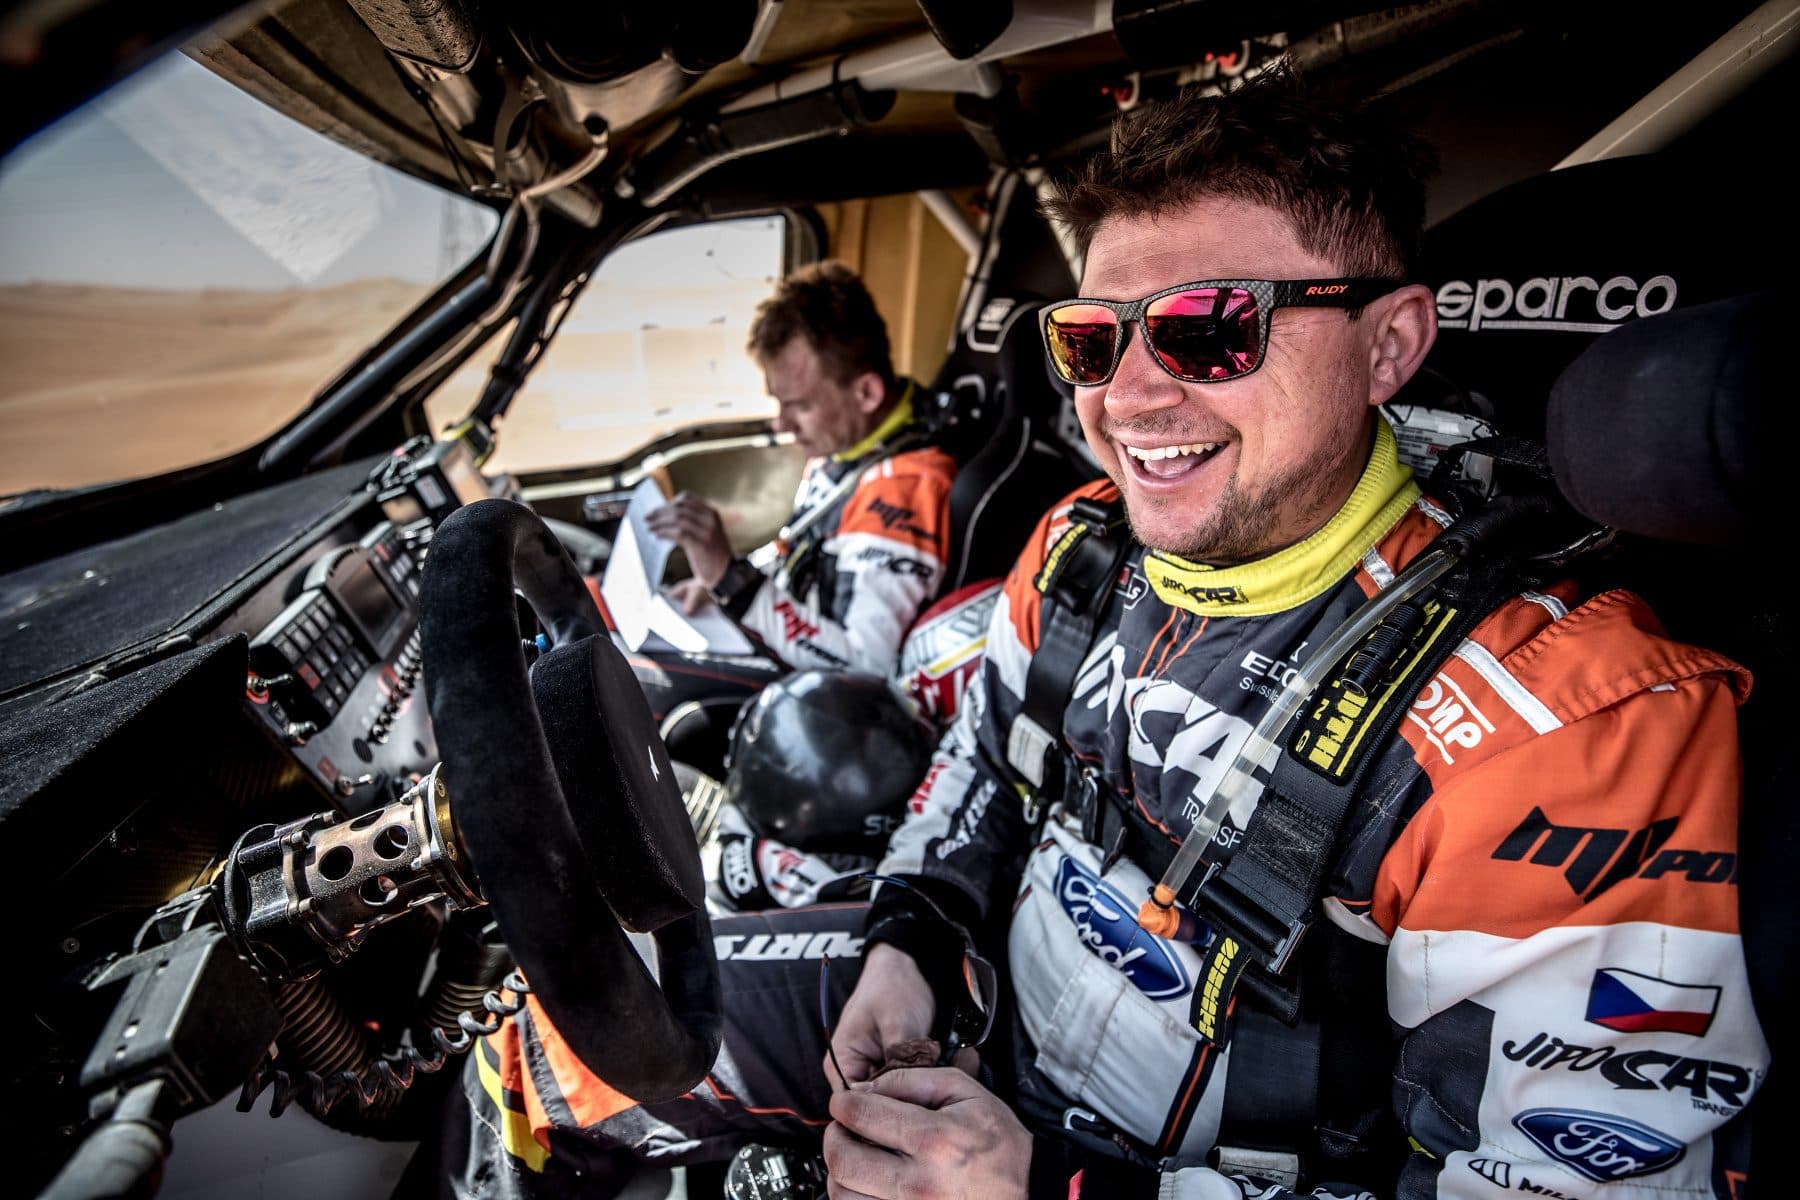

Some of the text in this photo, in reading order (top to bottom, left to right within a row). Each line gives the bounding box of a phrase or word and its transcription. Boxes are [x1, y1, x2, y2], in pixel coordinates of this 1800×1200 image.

[1305, 284, 1349, 296] RUDY
[1436, 275, 1677, 331] sparco
[863, 814, 897, 836] St
[1063, 875, 1148, 976] Ford
[1552, 1121, 1662, 1176] For
[1517, 1176, 1580, 1200] MIL
